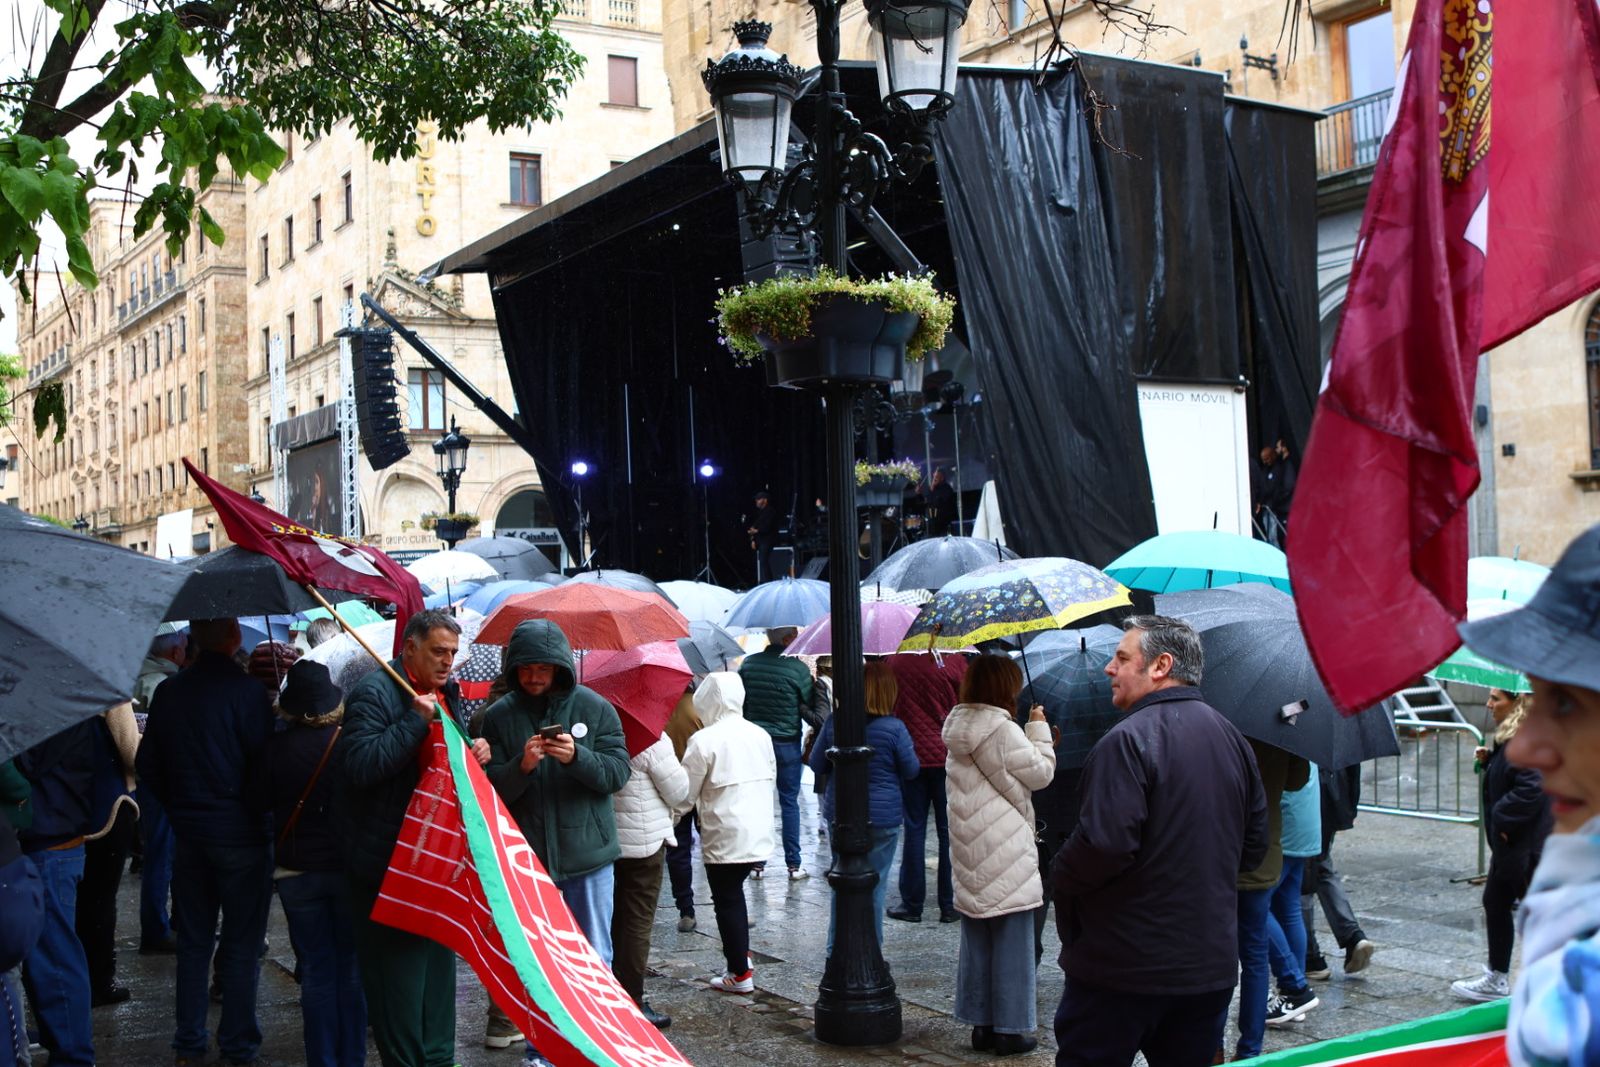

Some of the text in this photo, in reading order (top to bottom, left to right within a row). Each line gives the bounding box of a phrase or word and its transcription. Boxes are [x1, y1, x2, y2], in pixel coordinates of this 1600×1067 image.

[1190, 391, 1229, 404] MÓVIL
[385, 535, 408, 545] GRUPO
[520, 531, 558, 541] CaixaBank
